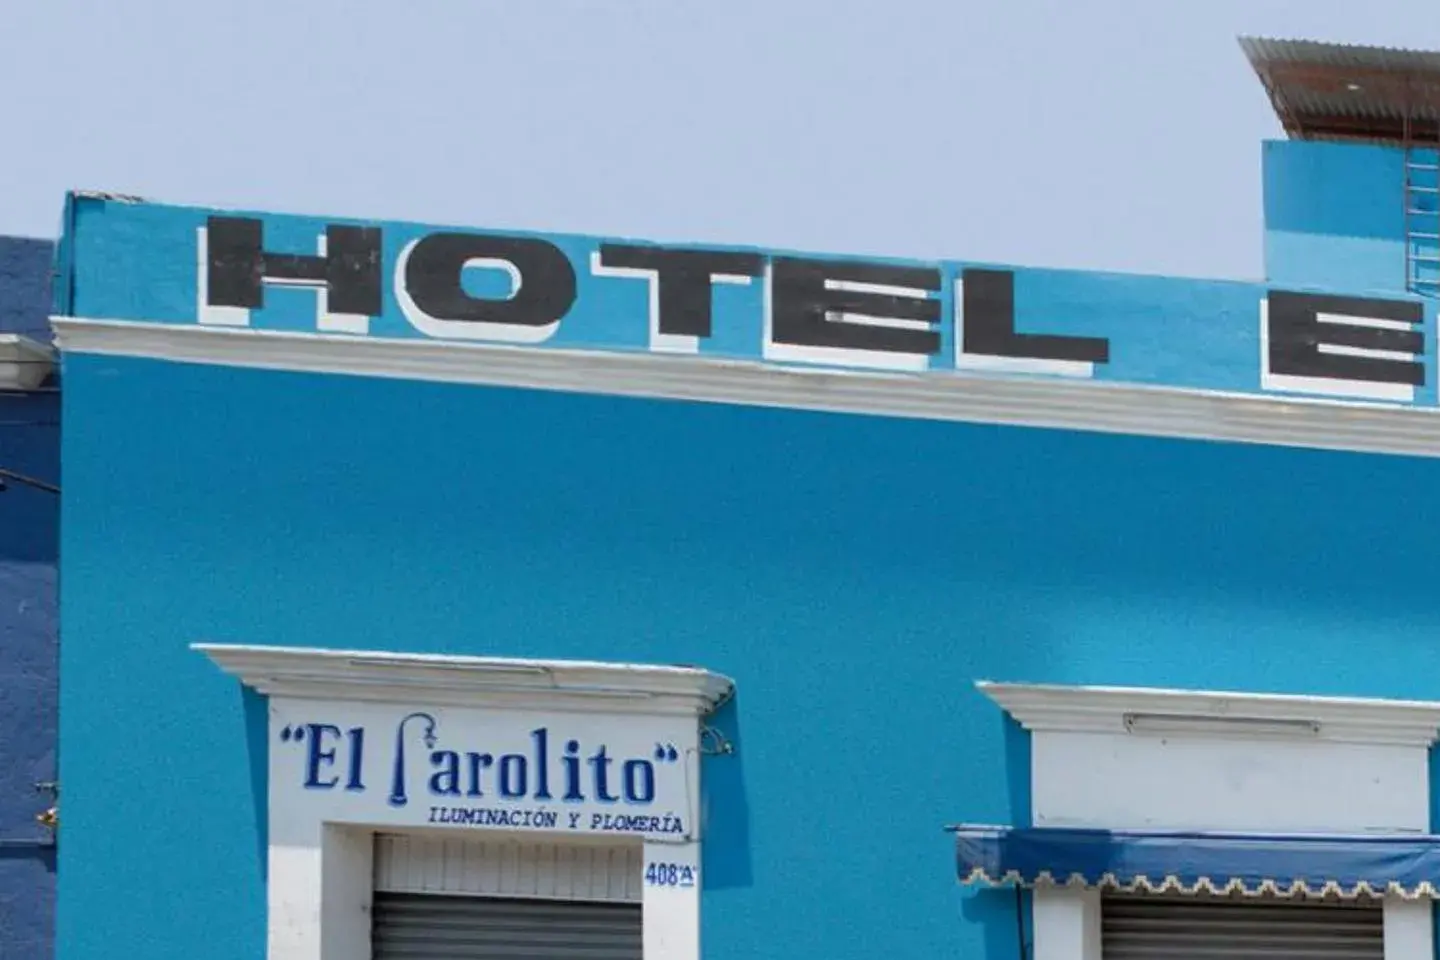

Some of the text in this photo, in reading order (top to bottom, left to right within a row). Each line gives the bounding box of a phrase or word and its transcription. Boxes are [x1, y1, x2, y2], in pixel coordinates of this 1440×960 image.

[198, 215, 1109, 375] HOTEL
[428, 806, 684, 834] ILUMINACIÓN Y PLOMERÍA
